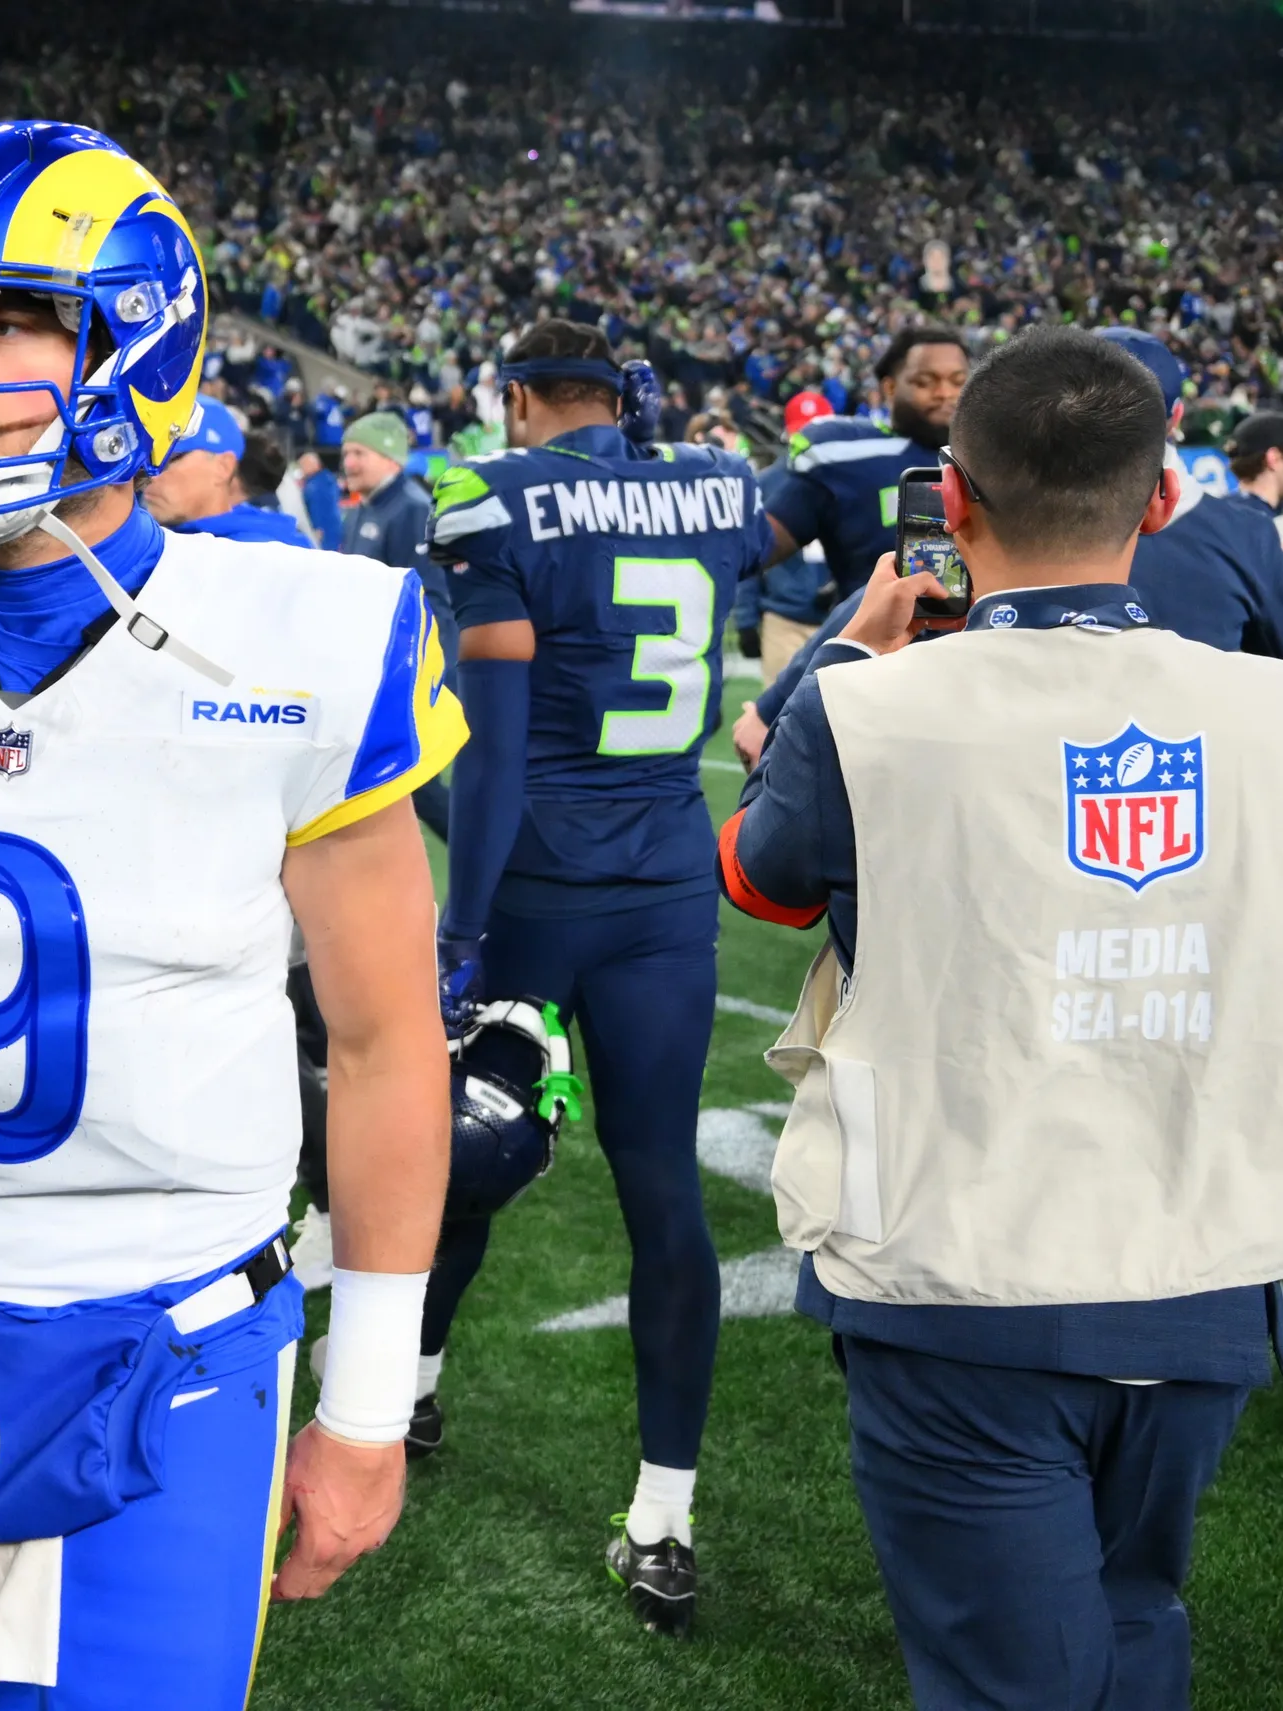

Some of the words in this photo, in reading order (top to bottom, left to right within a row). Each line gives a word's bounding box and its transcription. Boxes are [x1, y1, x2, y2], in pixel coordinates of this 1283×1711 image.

[992, 609, 1016, 625] 50
[596, 557, 715, 756] 3
[192, 700, 307, 725] RAMS
[1081, 796, 1191, 872] NFL
[1056, 923, 1210, 981] MEDIA
[1050, 990, 1212, 1043] SEA-014
